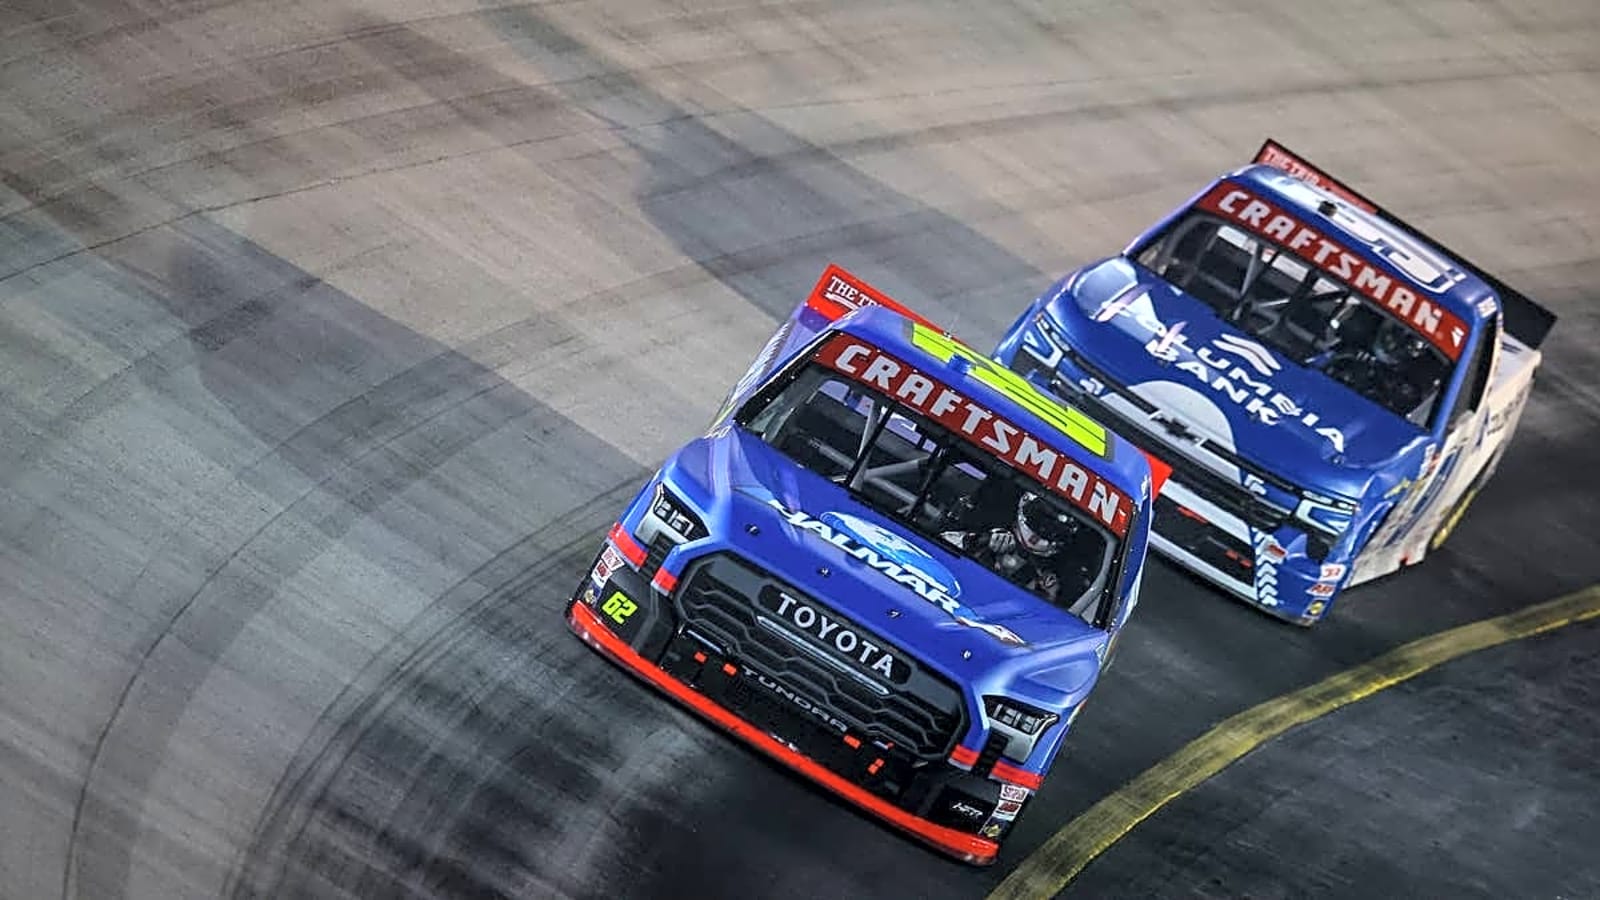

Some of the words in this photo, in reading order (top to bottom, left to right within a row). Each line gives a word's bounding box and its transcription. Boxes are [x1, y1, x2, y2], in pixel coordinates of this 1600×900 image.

[827, 275, 859, 301] THE
[1218, 190, 1444, 335] CRAFTSMAN
[1145, 339, 1280, 425] BANK
[835, 344, 1121, 525] CRAFTSMAN
[601, 591, 638, 625] 62
[775, 592, 895, 679] TOYOTA
[741, 664, 848, 732] TUNDRA
